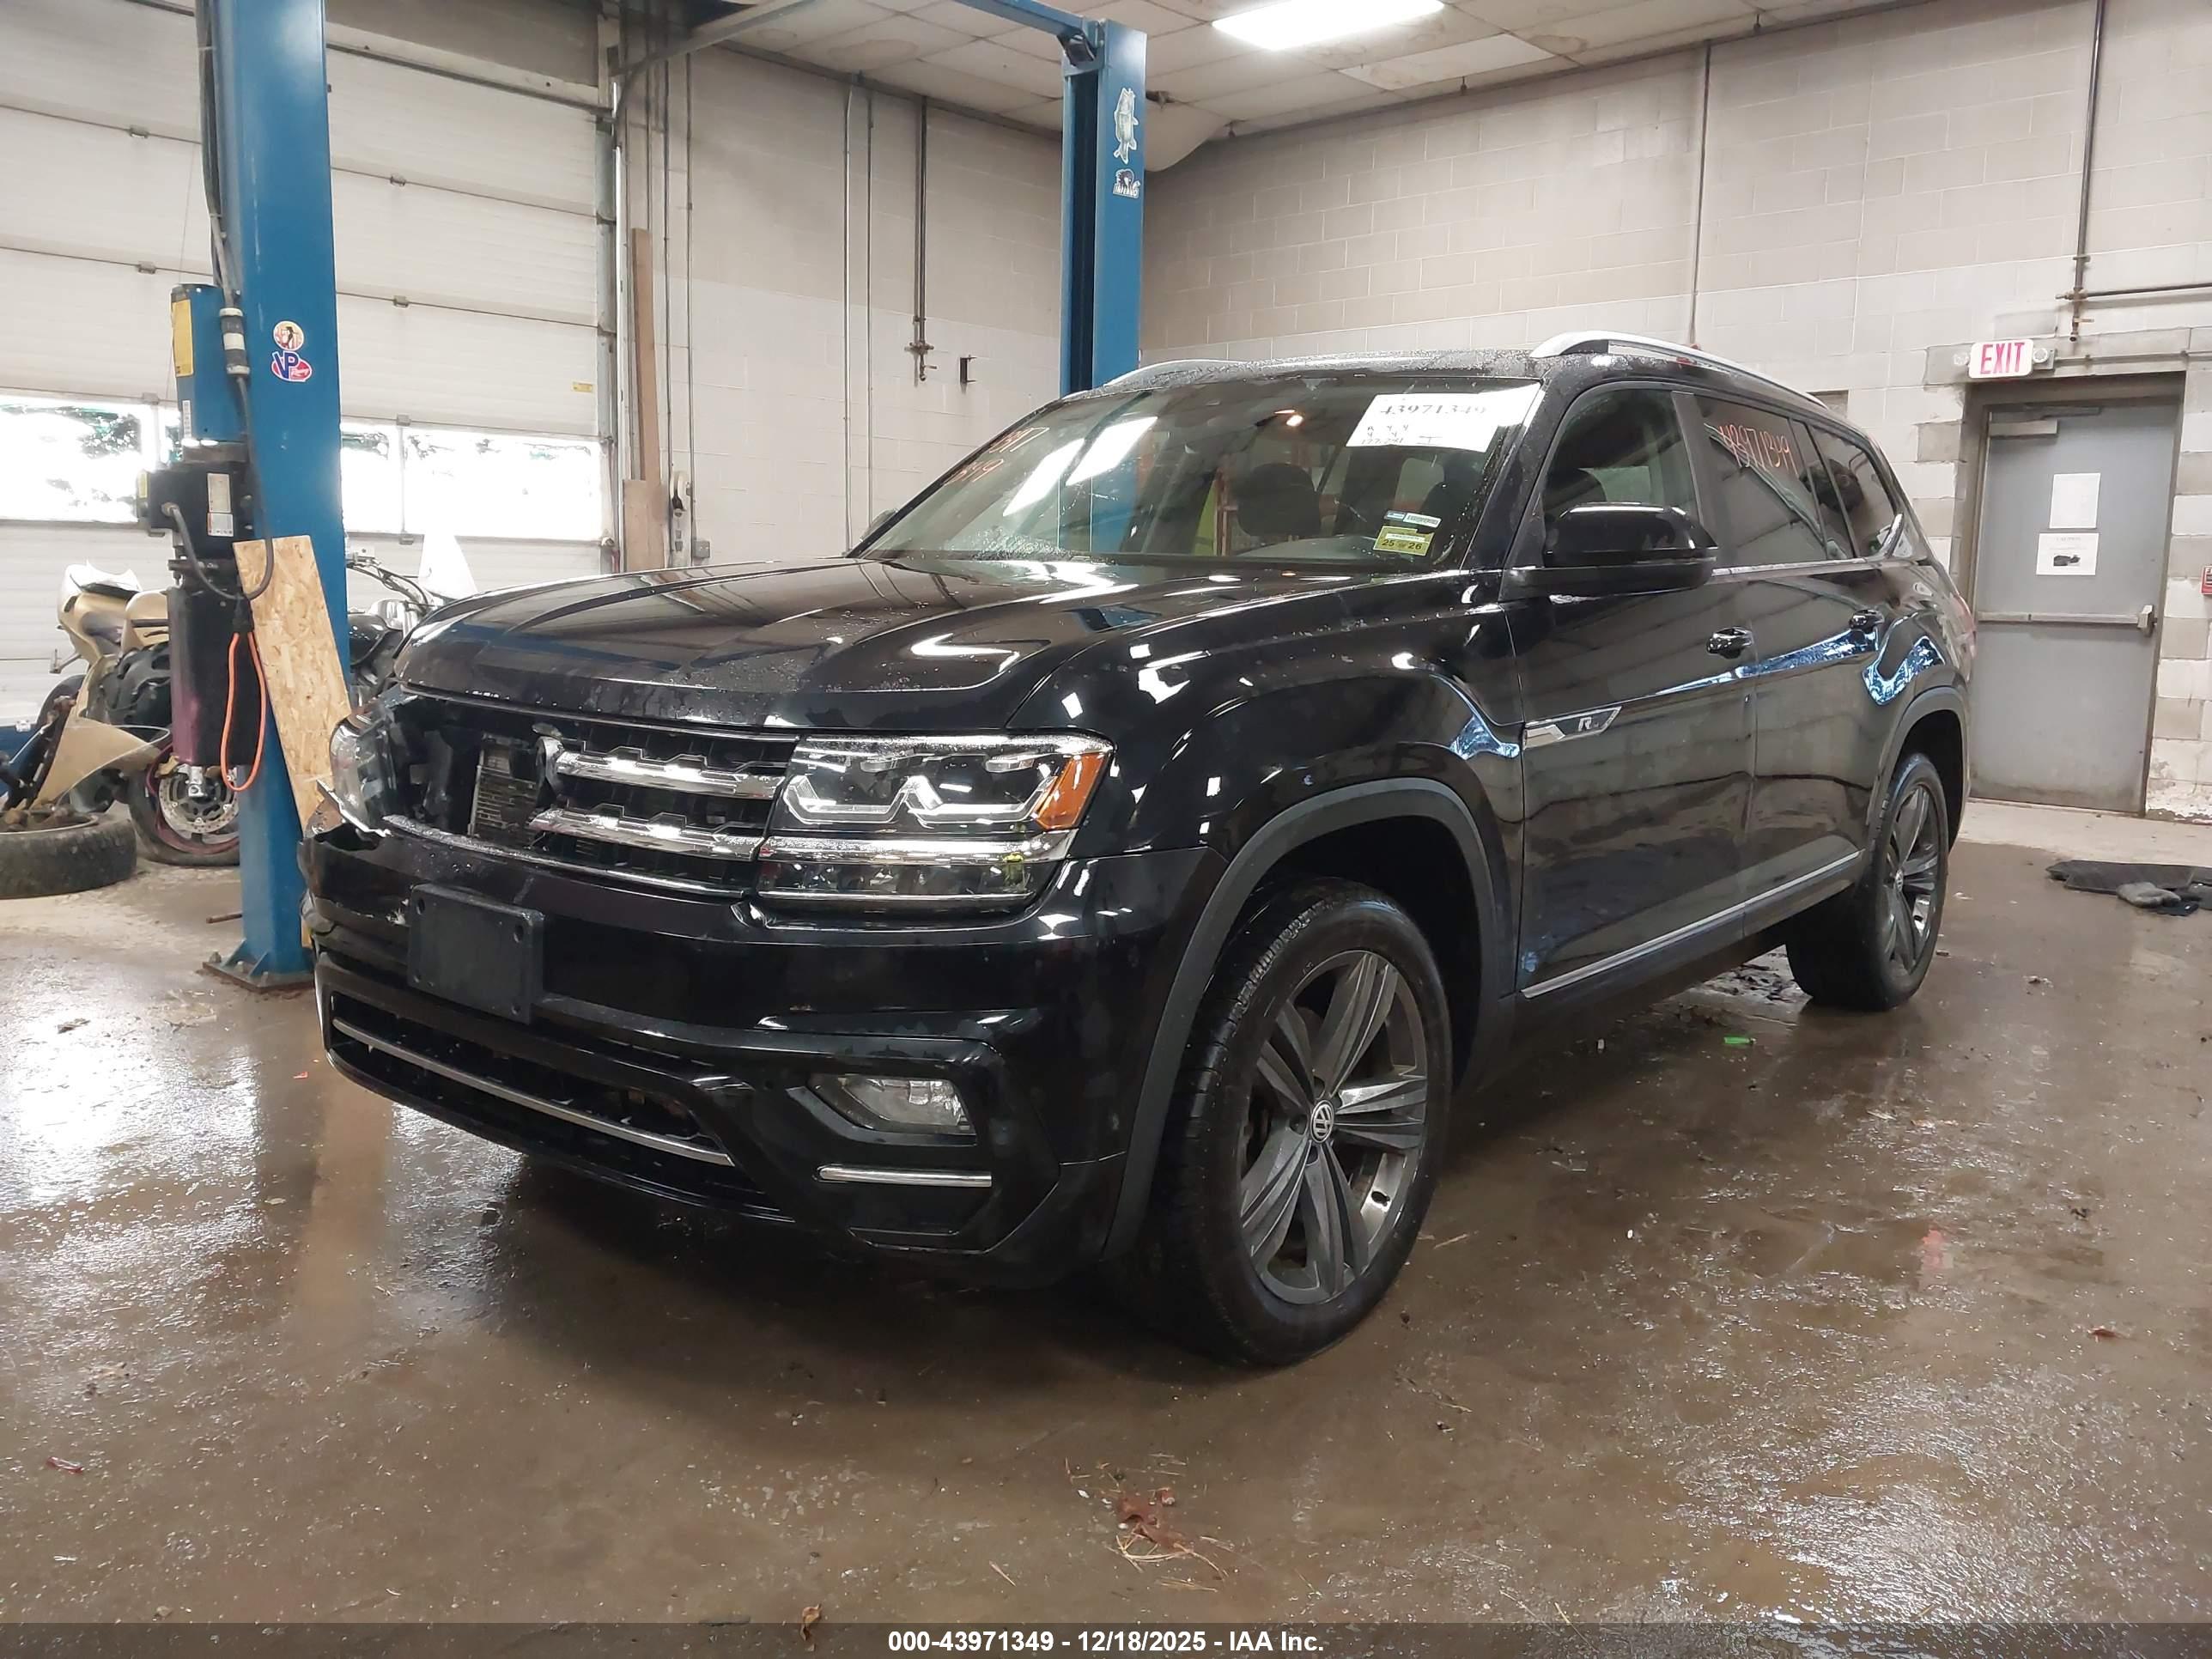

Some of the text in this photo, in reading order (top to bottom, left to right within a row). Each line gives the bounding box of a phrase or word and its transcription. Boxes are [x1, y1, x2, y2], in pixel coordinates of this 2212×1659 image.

[272, 350, 300, 380] VP
[1980, 343, 2025, 374] EXIT
[1578, 716, 1592, 732] R
